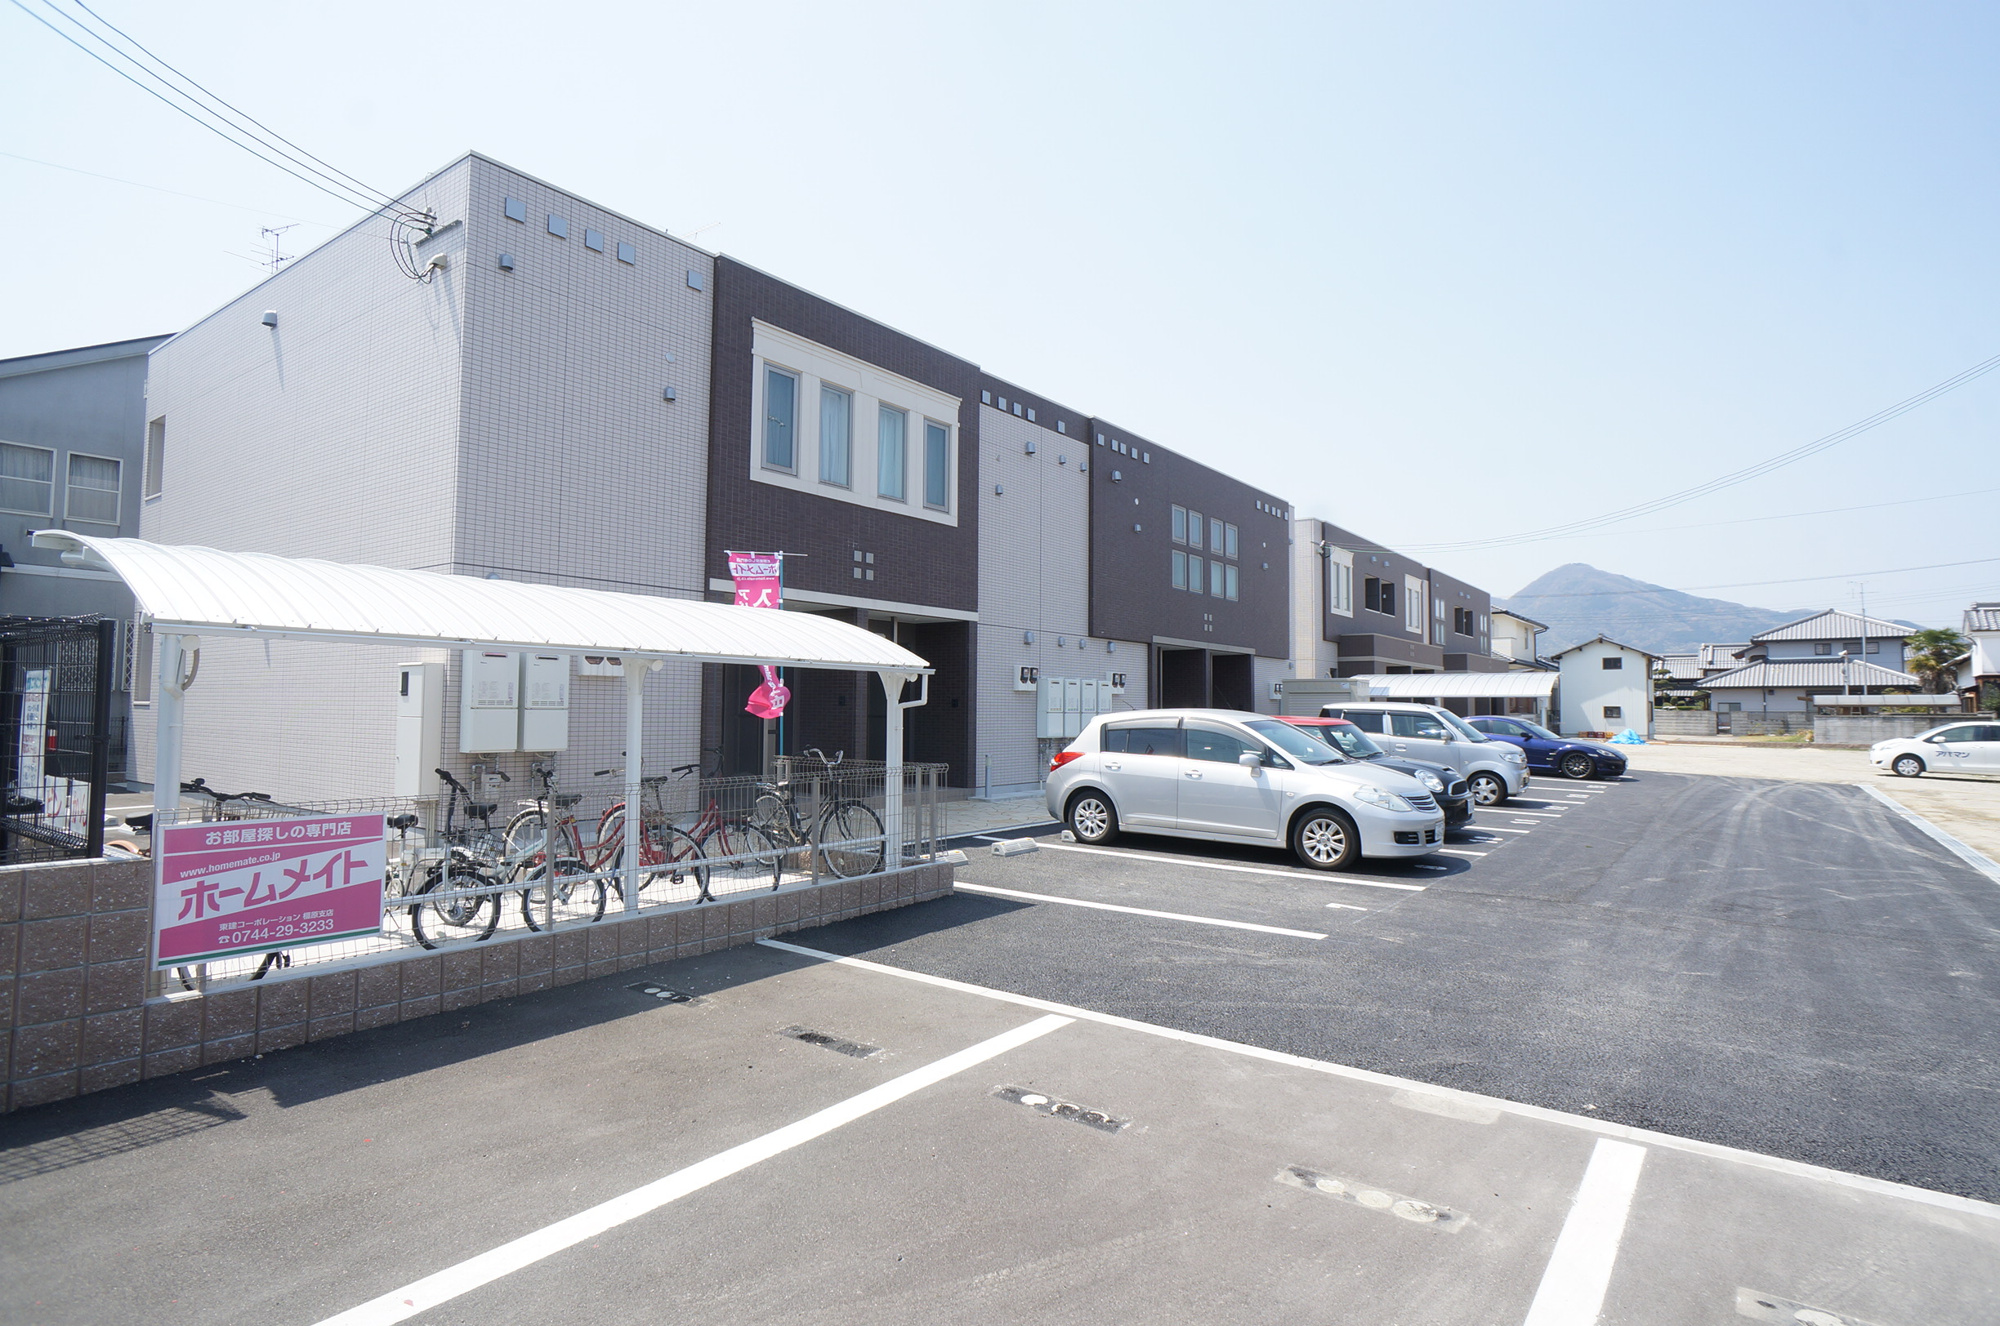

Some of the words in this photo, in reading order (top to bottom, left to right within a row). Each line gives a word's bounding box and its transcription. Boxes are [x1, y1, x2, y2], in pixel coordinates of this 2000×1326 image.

[205, 821, 352, 846] お部屋探しの専門店
[180, 851, 281, 878] www.homemate.co.jp
[178, 850, 368, 921] ホームメイト
[219, 914, 301, 931] 東建コーポレーション
[232, 918, 334, 943] 0744-29-3233
